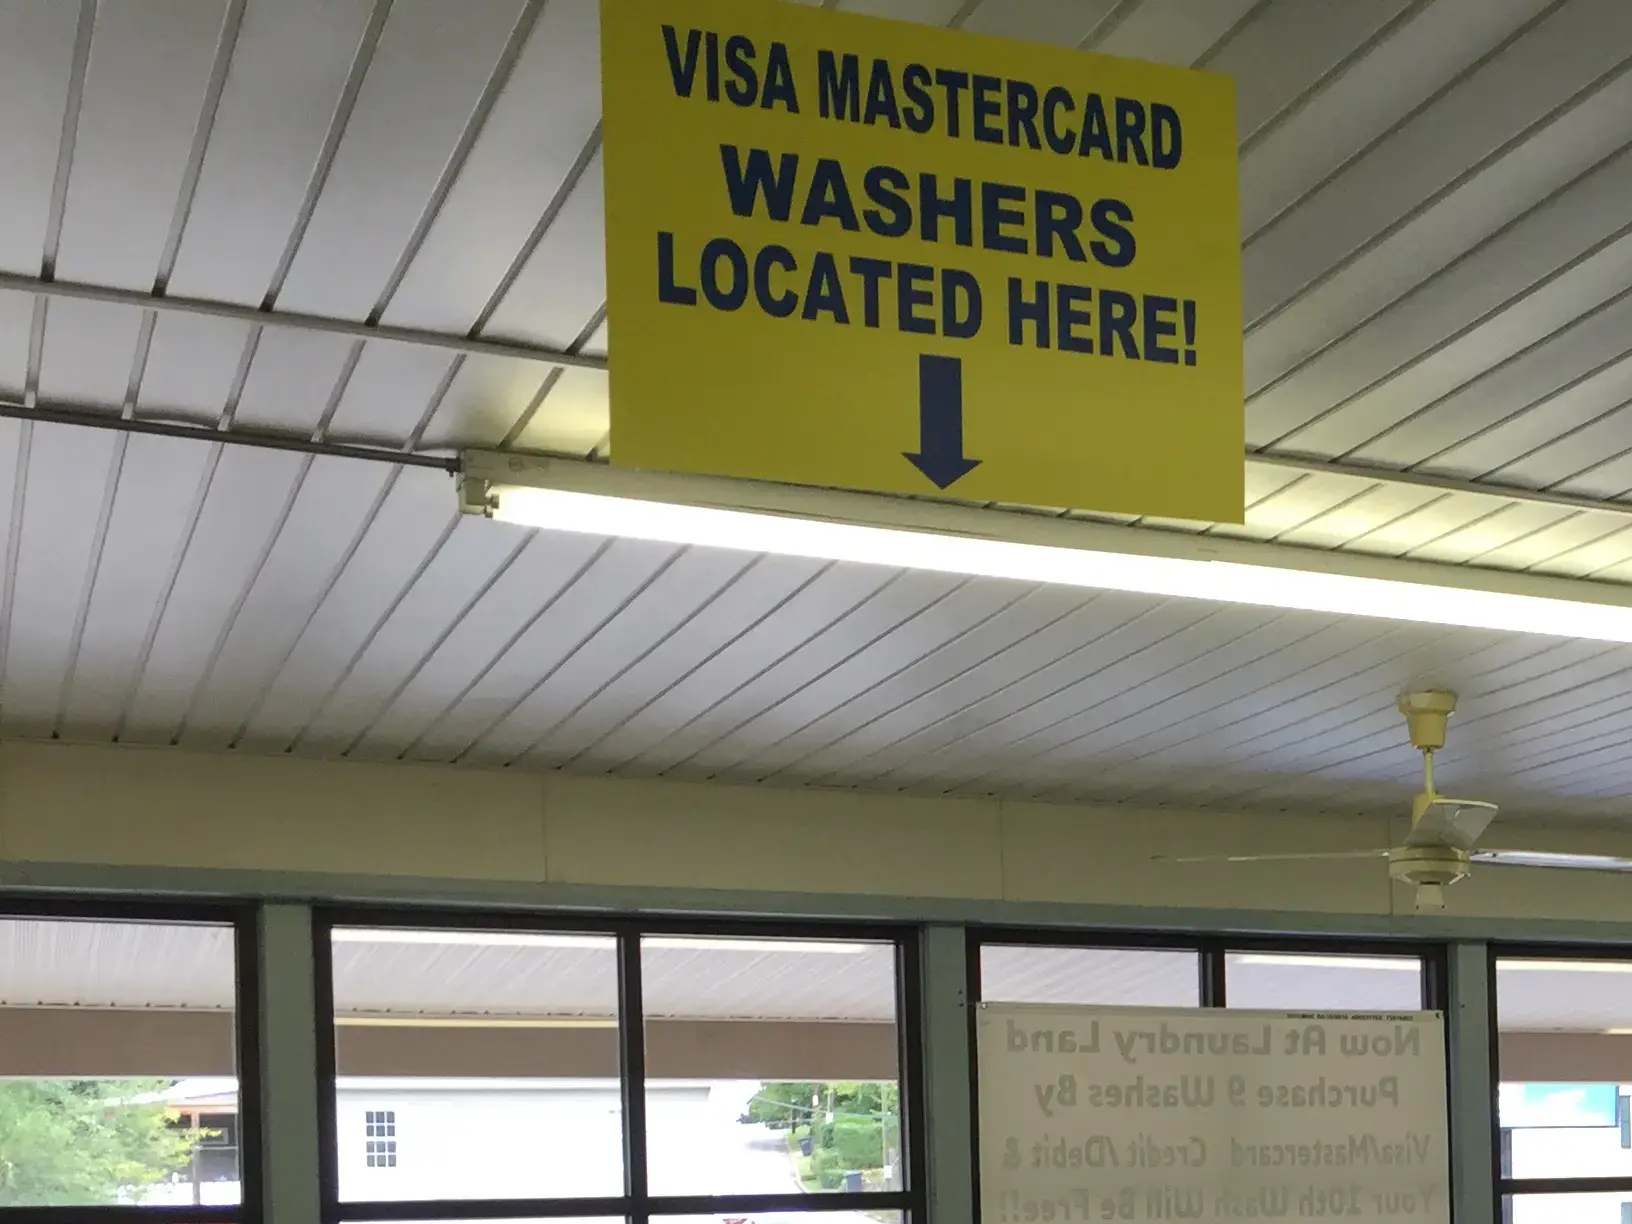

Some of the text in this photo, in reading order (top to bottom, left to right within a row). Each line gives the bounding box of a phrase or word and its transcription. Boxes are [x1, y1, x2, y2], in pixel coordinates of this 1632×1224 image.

[661, 24, 1183, 170] VISA MASTERCARD
[719, 143, 1137, 268] WASHERS
[656, 231, 1198, 367] LOCATED HERE!
